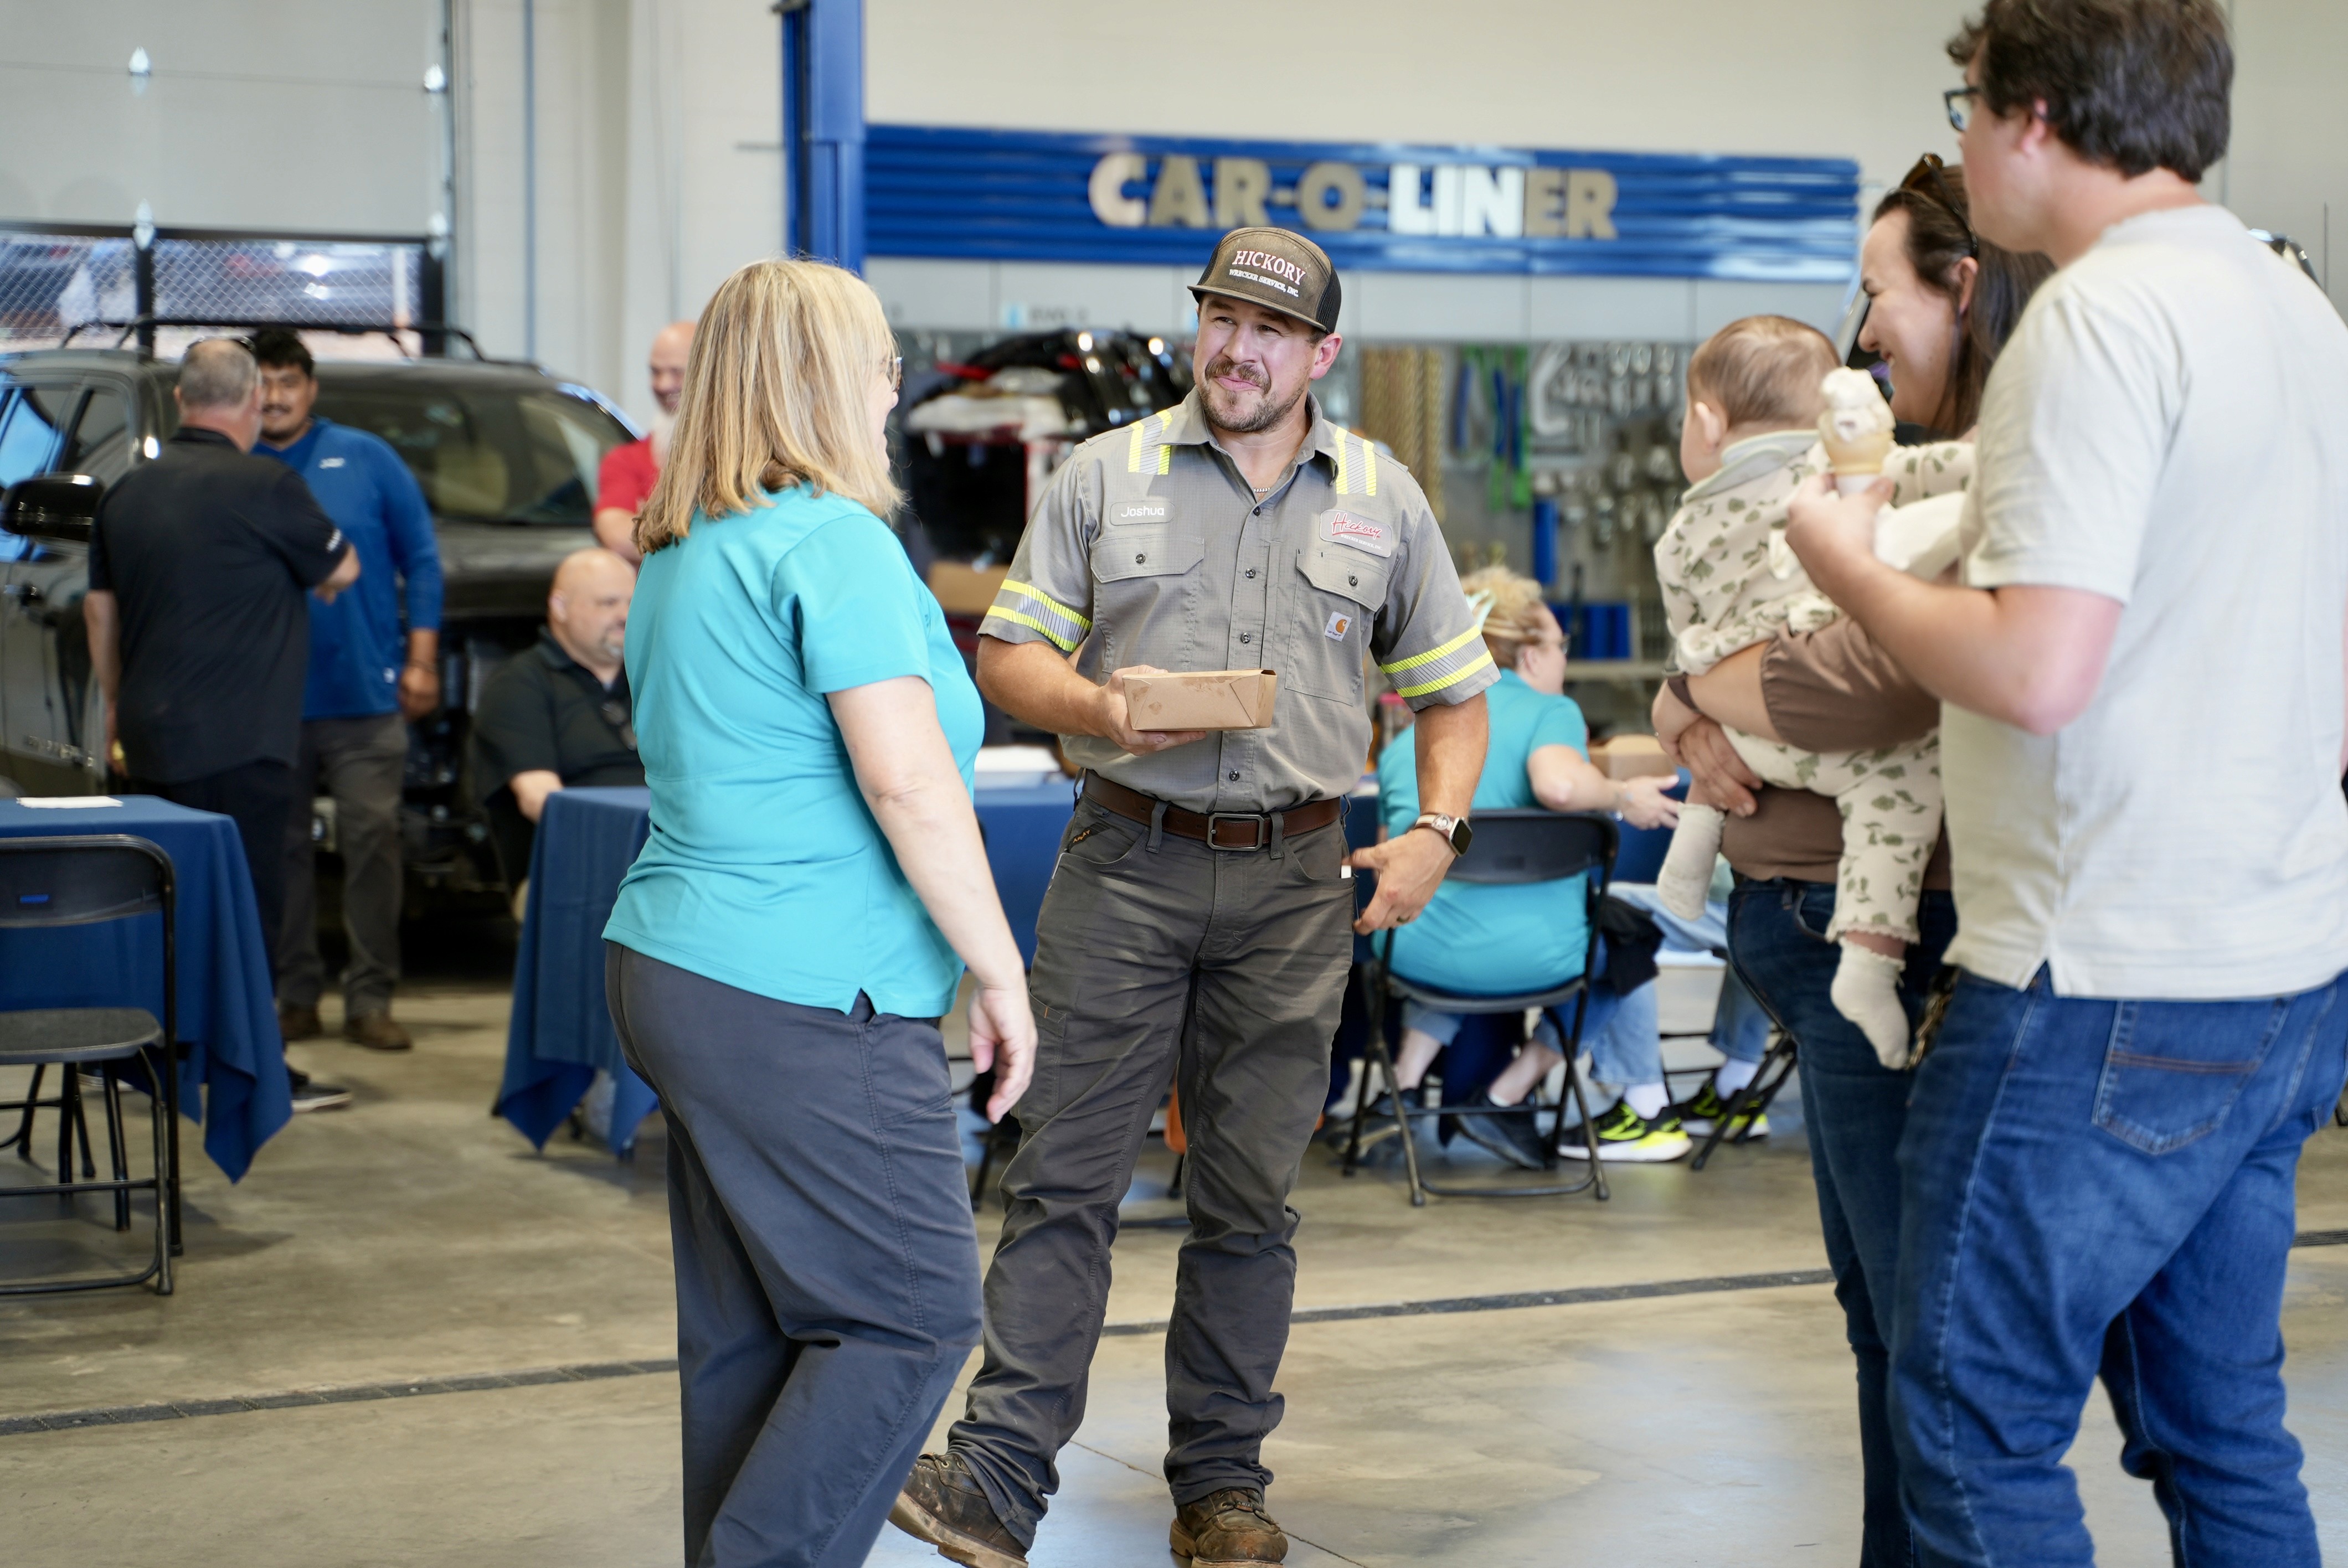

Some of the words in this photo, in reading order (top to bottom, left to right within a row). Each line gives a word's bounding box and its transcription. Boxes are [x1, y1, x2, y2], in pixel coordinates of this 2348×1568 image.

[1088, 153, 1618, 239] CAR-O-LINER
[1232, 250, 1306, 286] HICKORY
[1229, 269, 1258, 282] WRECKER
[1259, 275, 1286, 293] SERVICE,
[1286, 286, 1299, 298] INC.
[1120, 506, 1165, 518] Joshua
[1331, 513, 1382, 540] Hickory
[1341, 534, 1358, 542] WRECKER
